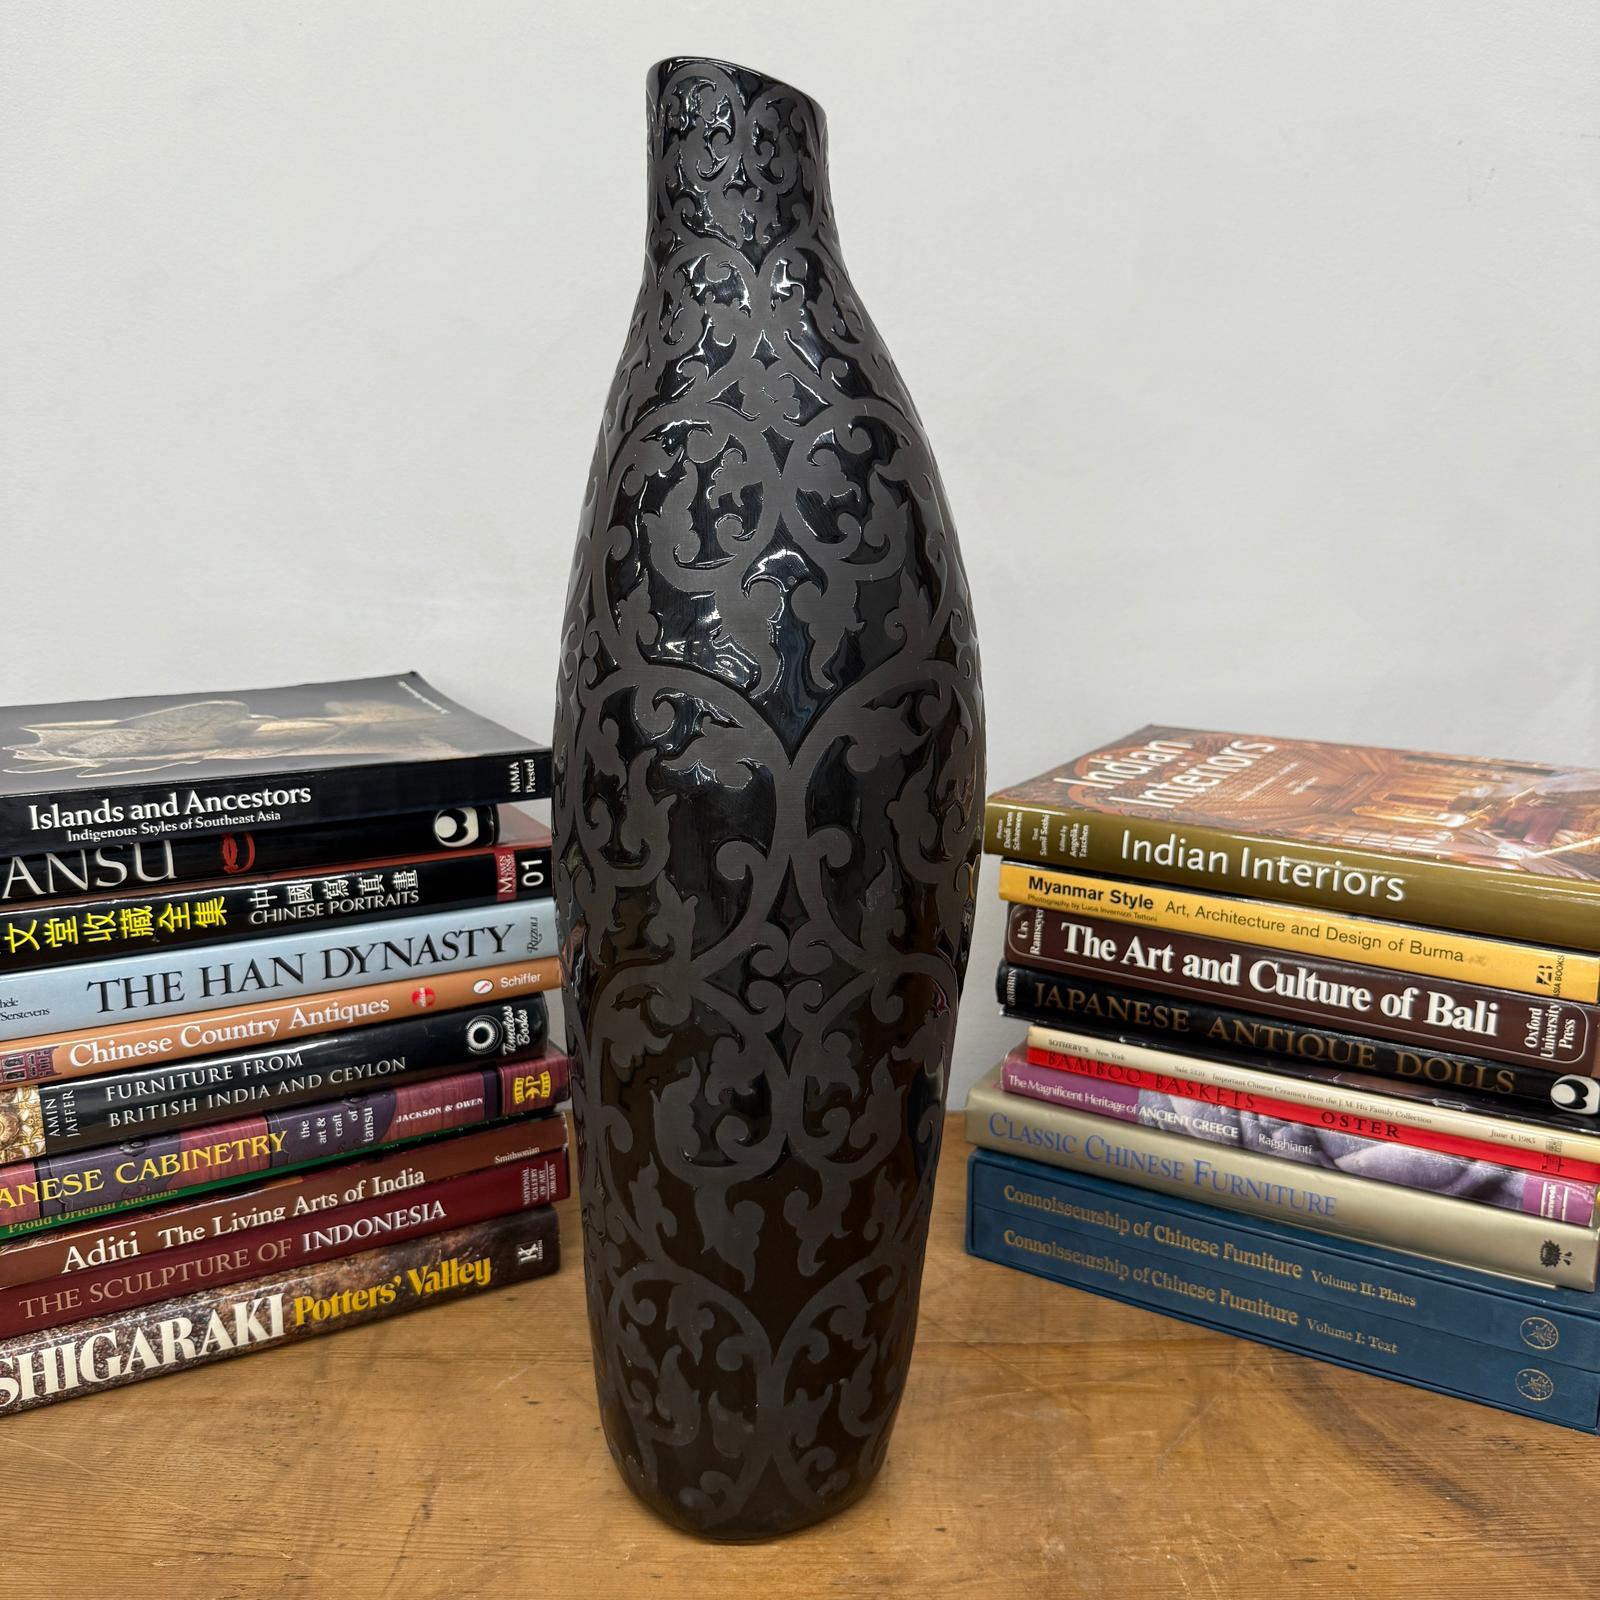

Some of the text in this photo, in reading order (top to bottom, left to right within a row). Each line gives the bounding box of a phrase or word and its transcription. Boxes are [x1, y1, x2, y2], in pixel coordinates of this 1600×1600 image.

[510, 762, 521, 793] MMA
[525, 759, 536, 793] Prestel
[1053, 738, 1194, 790] Indian
[1108, 738, 1277, 809] Interiors
[28, 787, 312, 831] Islands and Ancestors
[68, 811, 281, 842] Indigenous Styles of Southeast Asia
[1079, 824, 1089, 857] Taschen
[521, 860, 544, 887] 01
[1121, 830, 1406, 902] Indian Interiors
[5, 896, 228, 954] 文堂收藏全集
[250, 890, 420, 925] CHINESE PORTRAITS
[1028, 875, 1464, 963] Myanmar Style Art, Architecture and Design of Burma
[1071, 901, 1080, 911] by
[1081, 903, 1099, 913] Luca
[1017, 920, 1029, 939] Urs
[1029, 907, 1045, 955] Ramseyer
[86, 923, 516, 1014] THE HAN DYNASTY
[500, 972, 542, 989] Schiffer
[1007, 968, 1017, 1006] GRIBBIN
[1061, 922, 1500, 1037] The Art and Culture of Bali
[1554, 954, 1565, 982] BOOKS
[69, 999, 390, 1068] Chinese Country Antiques
[502, 1005, 516, 1056] Timeless
[515, 1009, 530, 1046] Books
[1033, 982, 1516, 1095] JAPANESE ANTIQUE DOLLS
[1523, 1007, 1543, 1049] Oxford
[1540, 1002, 1563, 1058] University
[1558, 1018, 1576, 1050] Press
[105, 1052, 303, 1102] FURNITURE FROM
[109, 1056, 406, 1128] BRITISH INDIA AND CEYLON
[1048, 1051, 1400, 1138] BAMBOO BASKETS OSTER
[46, 1098, 61, 1138] AMIN
[62, 1089, 82, 1138] JAFFER
[300, 1119, 310, 1138] the
[316, 1117, 327, 1144] art &
[332, 1112, 343, 1137] craft
[348, 1109, 358, 1121] of
[362, 1106, 374, 1143] tansu
[395, 1097, 484, 1123] JACKSON & OWEN
[1008, 1075, 1313, 1156] The Magnificent Heritage of ANCIENT GREECE Ragghianti
[1326, 1096, 1337, 1105] the
[1369, 1105, 1394, 1118] Family
[1395, 1110, 1433, 1124] Collection
[115, 1130, 289, 1185] CABINETRY
[495, 1146, 540, 1164] Smithsonian
[988, 1112, 1337, 1217] CLASSIC CHINESE FURNITURE
[8, 1216, 52, 1234] Proud
[61, 1167, 426, 1274] Aditi The Living Arts of India
[18, 1200, 447, 1319] THE SCULPTURE OF INDONESIA
[1003, 1184, 1417, 1308] Connoisseurship of Chinese Furniture Volume II: Plates
[1003, 1229, 1398, 1355] Connoisseurship of Chinese Furniture Volume I: Text
[0, 1256, 492, 1408] SHIGARAKI Potters' Valley
